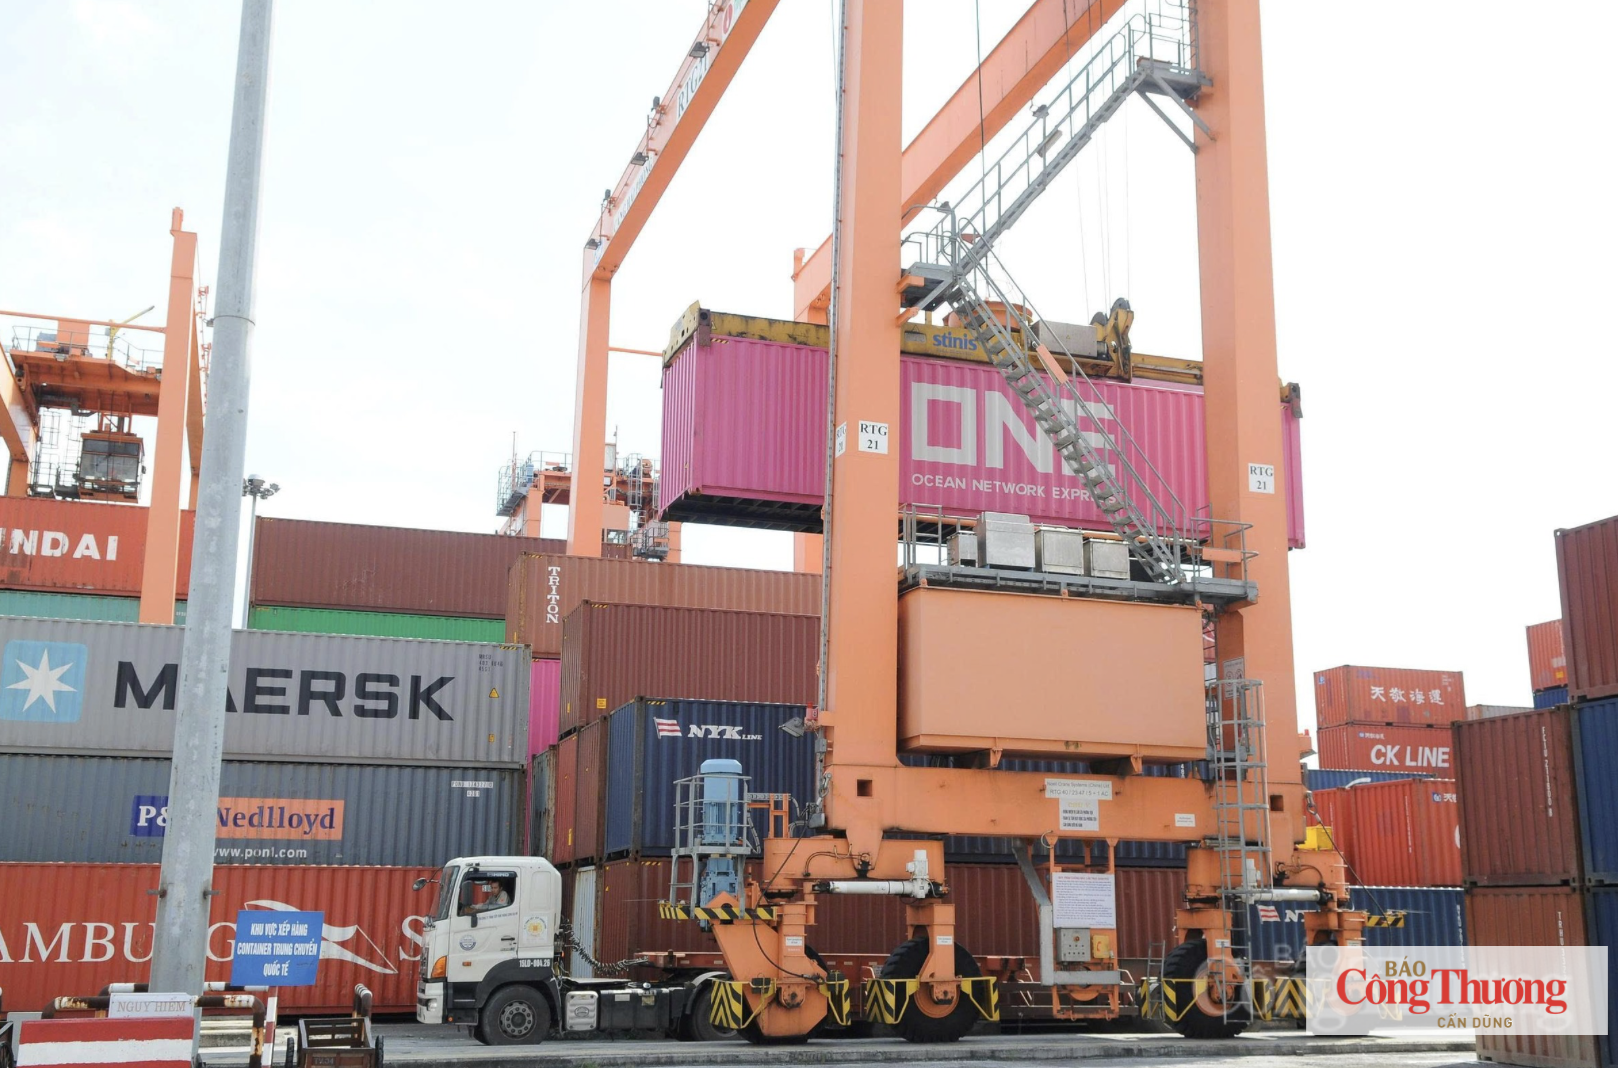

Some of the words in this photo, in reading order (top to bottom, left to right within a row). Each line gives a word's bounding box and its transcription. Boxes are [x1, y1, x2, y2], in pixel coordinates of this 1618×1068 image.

[932, 332, 978, 351] stinis
[860, 423, 888, 436] RTG
[867, 439, 879, 450] 21
[1250, 465, 1273, 477] RTG
[911, 473, 966, 489] OCEAN
[972, 479, 1046, 497] NETWORK
[1256, 480, 1267, 490] 21
[0, 527, 119, 561] NDAI
[546, 567, 560, 623] TRITON
[114, 661, 456, 721] MERSK
[688, 724, 743, 740] NYK
[1370, 744, 1400, 766] CK
[1405, 745, 1450, 768] LINE
[216, 805, 335, 835] Nedlloyd
[250, 923, 264, 936] KHU
[265, 922, 278, 938] VỰC
[278, 919, 290, 936] XẾP
[291, 920, 308, 936] HÀNG
[237, 942, 272, 955] CONTAINER
[273, 943, 293, 955] TRUNG
[294, 938, 318, 956] CHUYỂN
[263, 960, 280, 977] QUỐC
[281, 960, 290, 976] TẾ
[117, 1001, 152, 1013] NGUY
